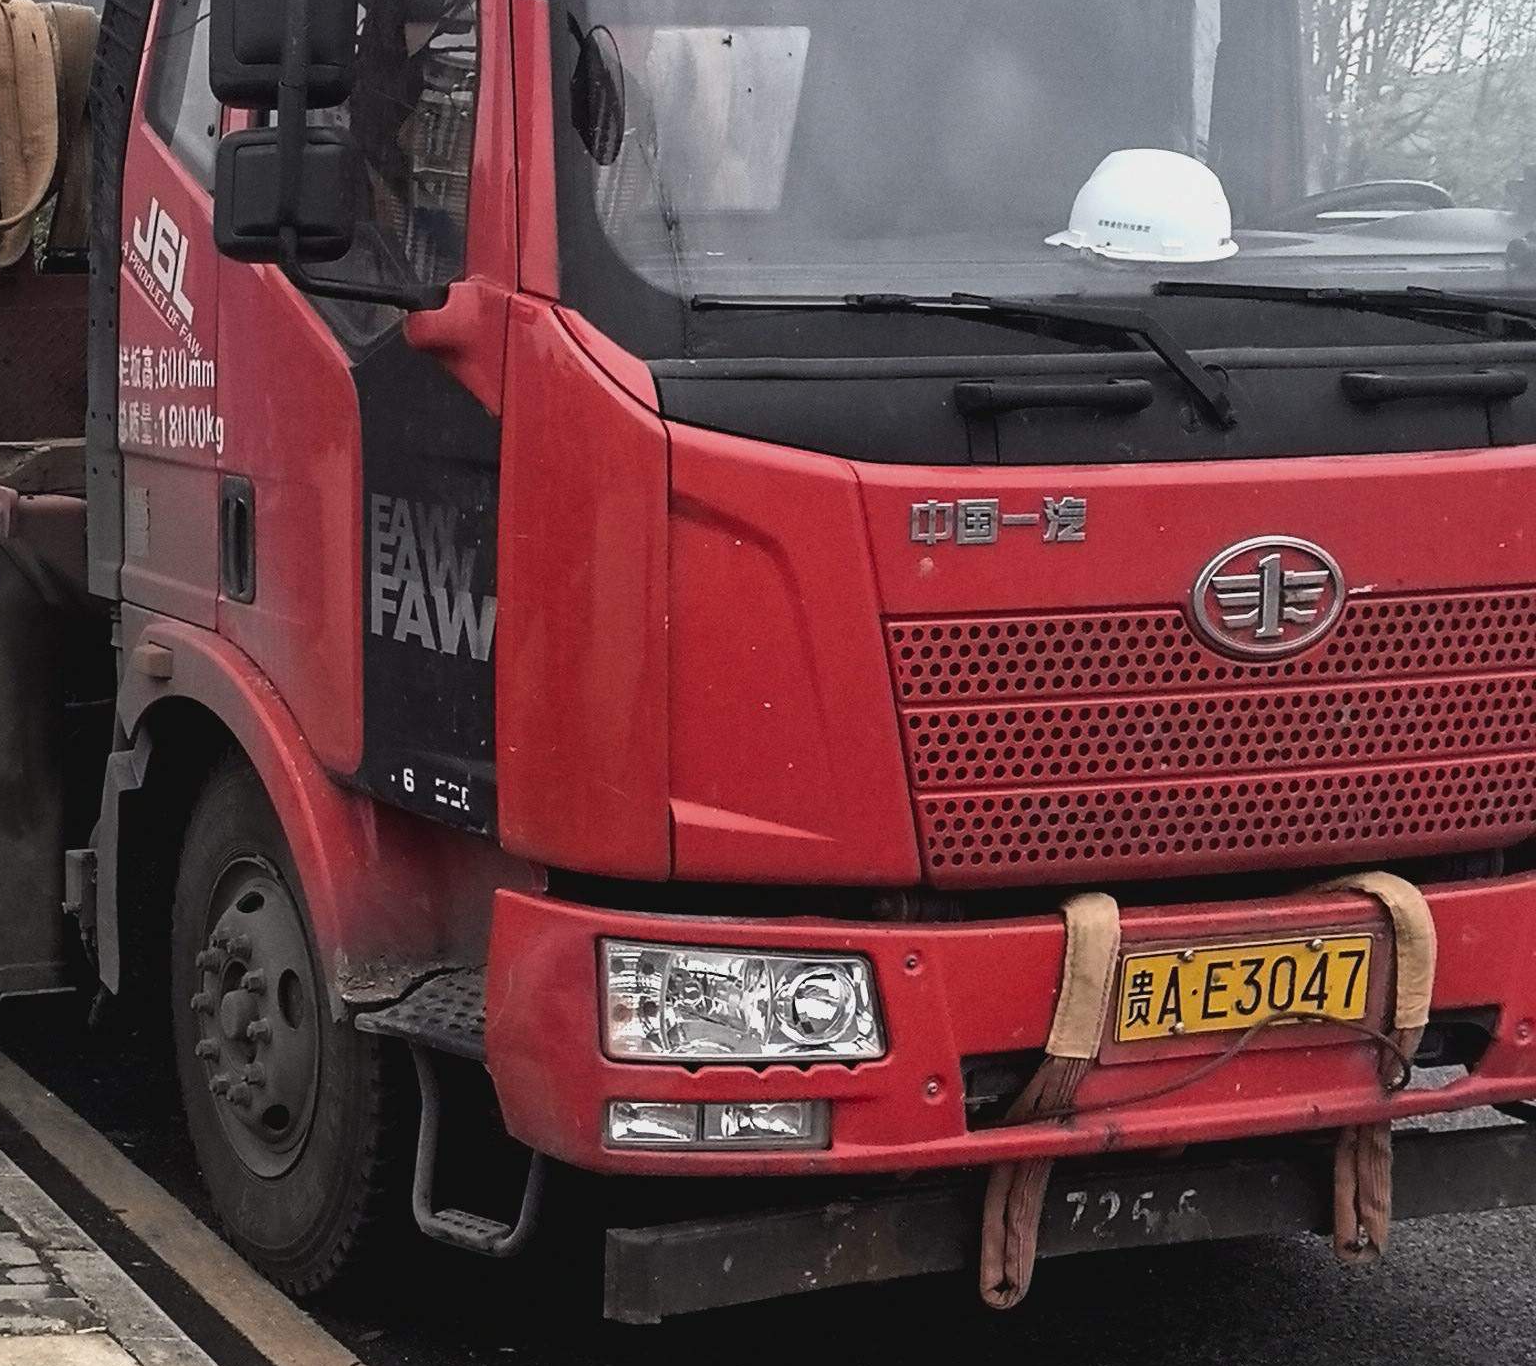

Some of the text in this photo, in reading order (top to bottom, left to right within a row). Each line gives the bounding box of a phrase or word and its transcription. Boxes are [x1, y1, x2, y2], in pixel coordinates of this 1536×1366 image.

[128, 249, 169, 310] PRODUCT
[166, 305, 182, 327] OF
[178, 322, 203, 358] FAW
[133, 196, 195, 325] J6L
[911, 496, 1087, 546] 中国一汽
[371, 571, 499, 663] FAW
